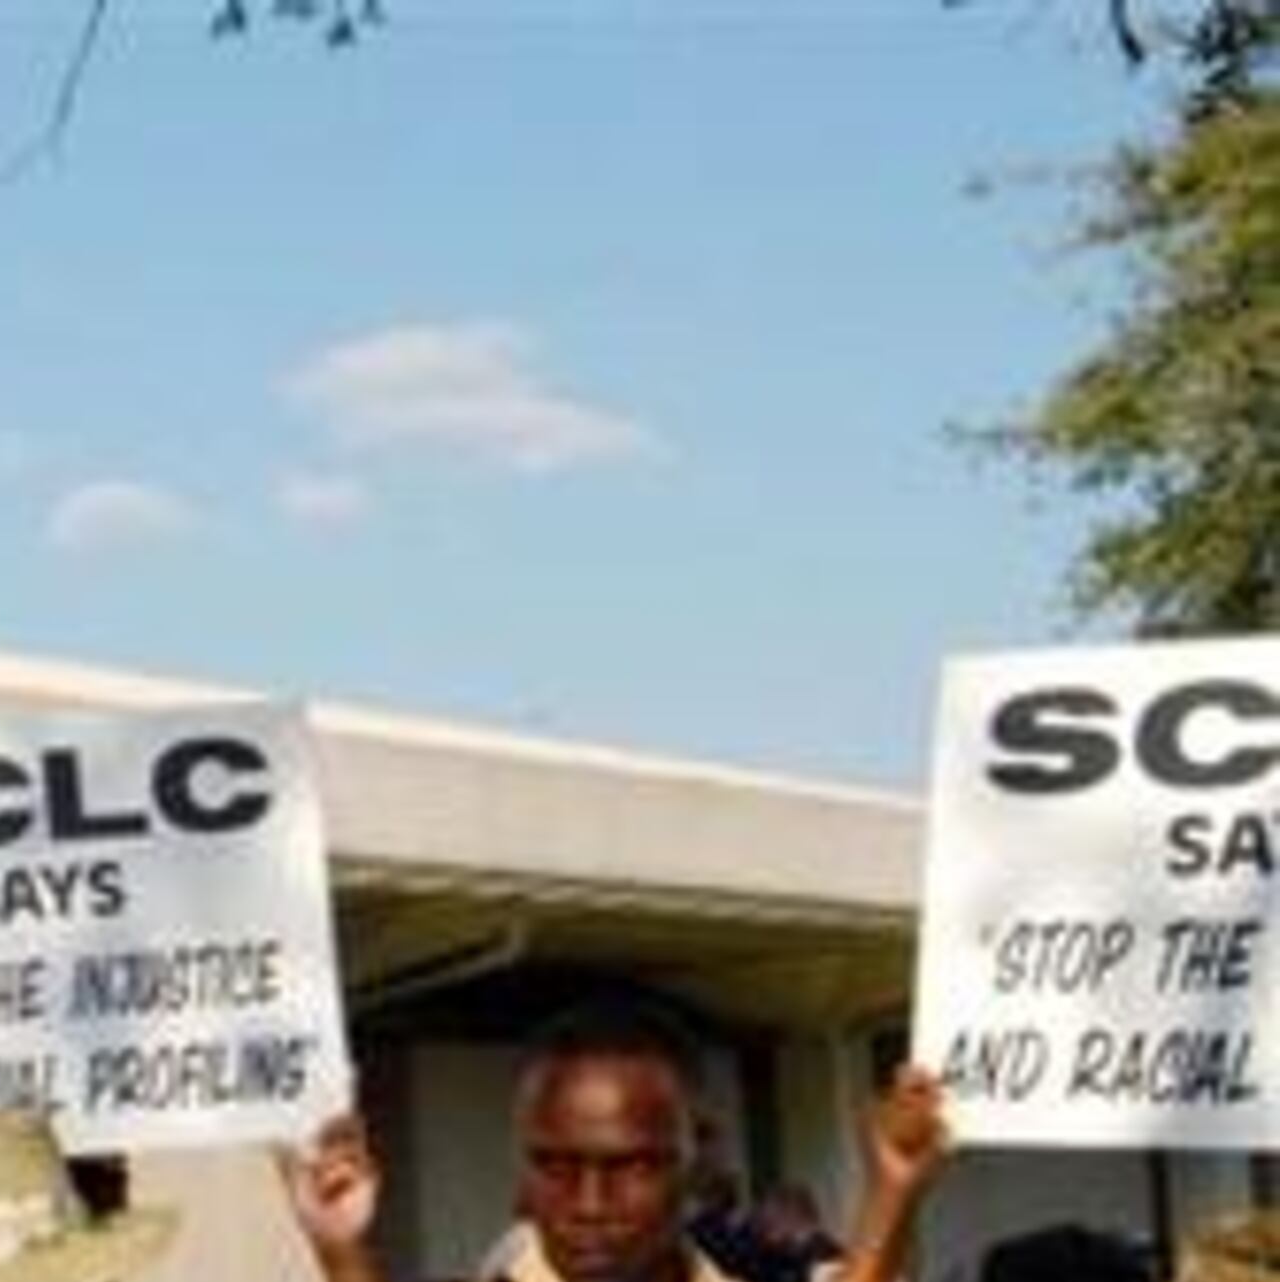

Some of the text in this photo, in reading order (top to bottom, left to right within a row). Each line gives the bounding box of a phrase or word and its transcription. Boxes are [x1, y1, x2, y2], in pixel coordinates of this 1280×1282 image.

[1166, 812, 1280, 878] SA
[69, 940, 282, 1019] INJUSTICE
[1156, 917, 1261, 995] THE
[943, 1027, 1258, 1105] AND RACIAL
